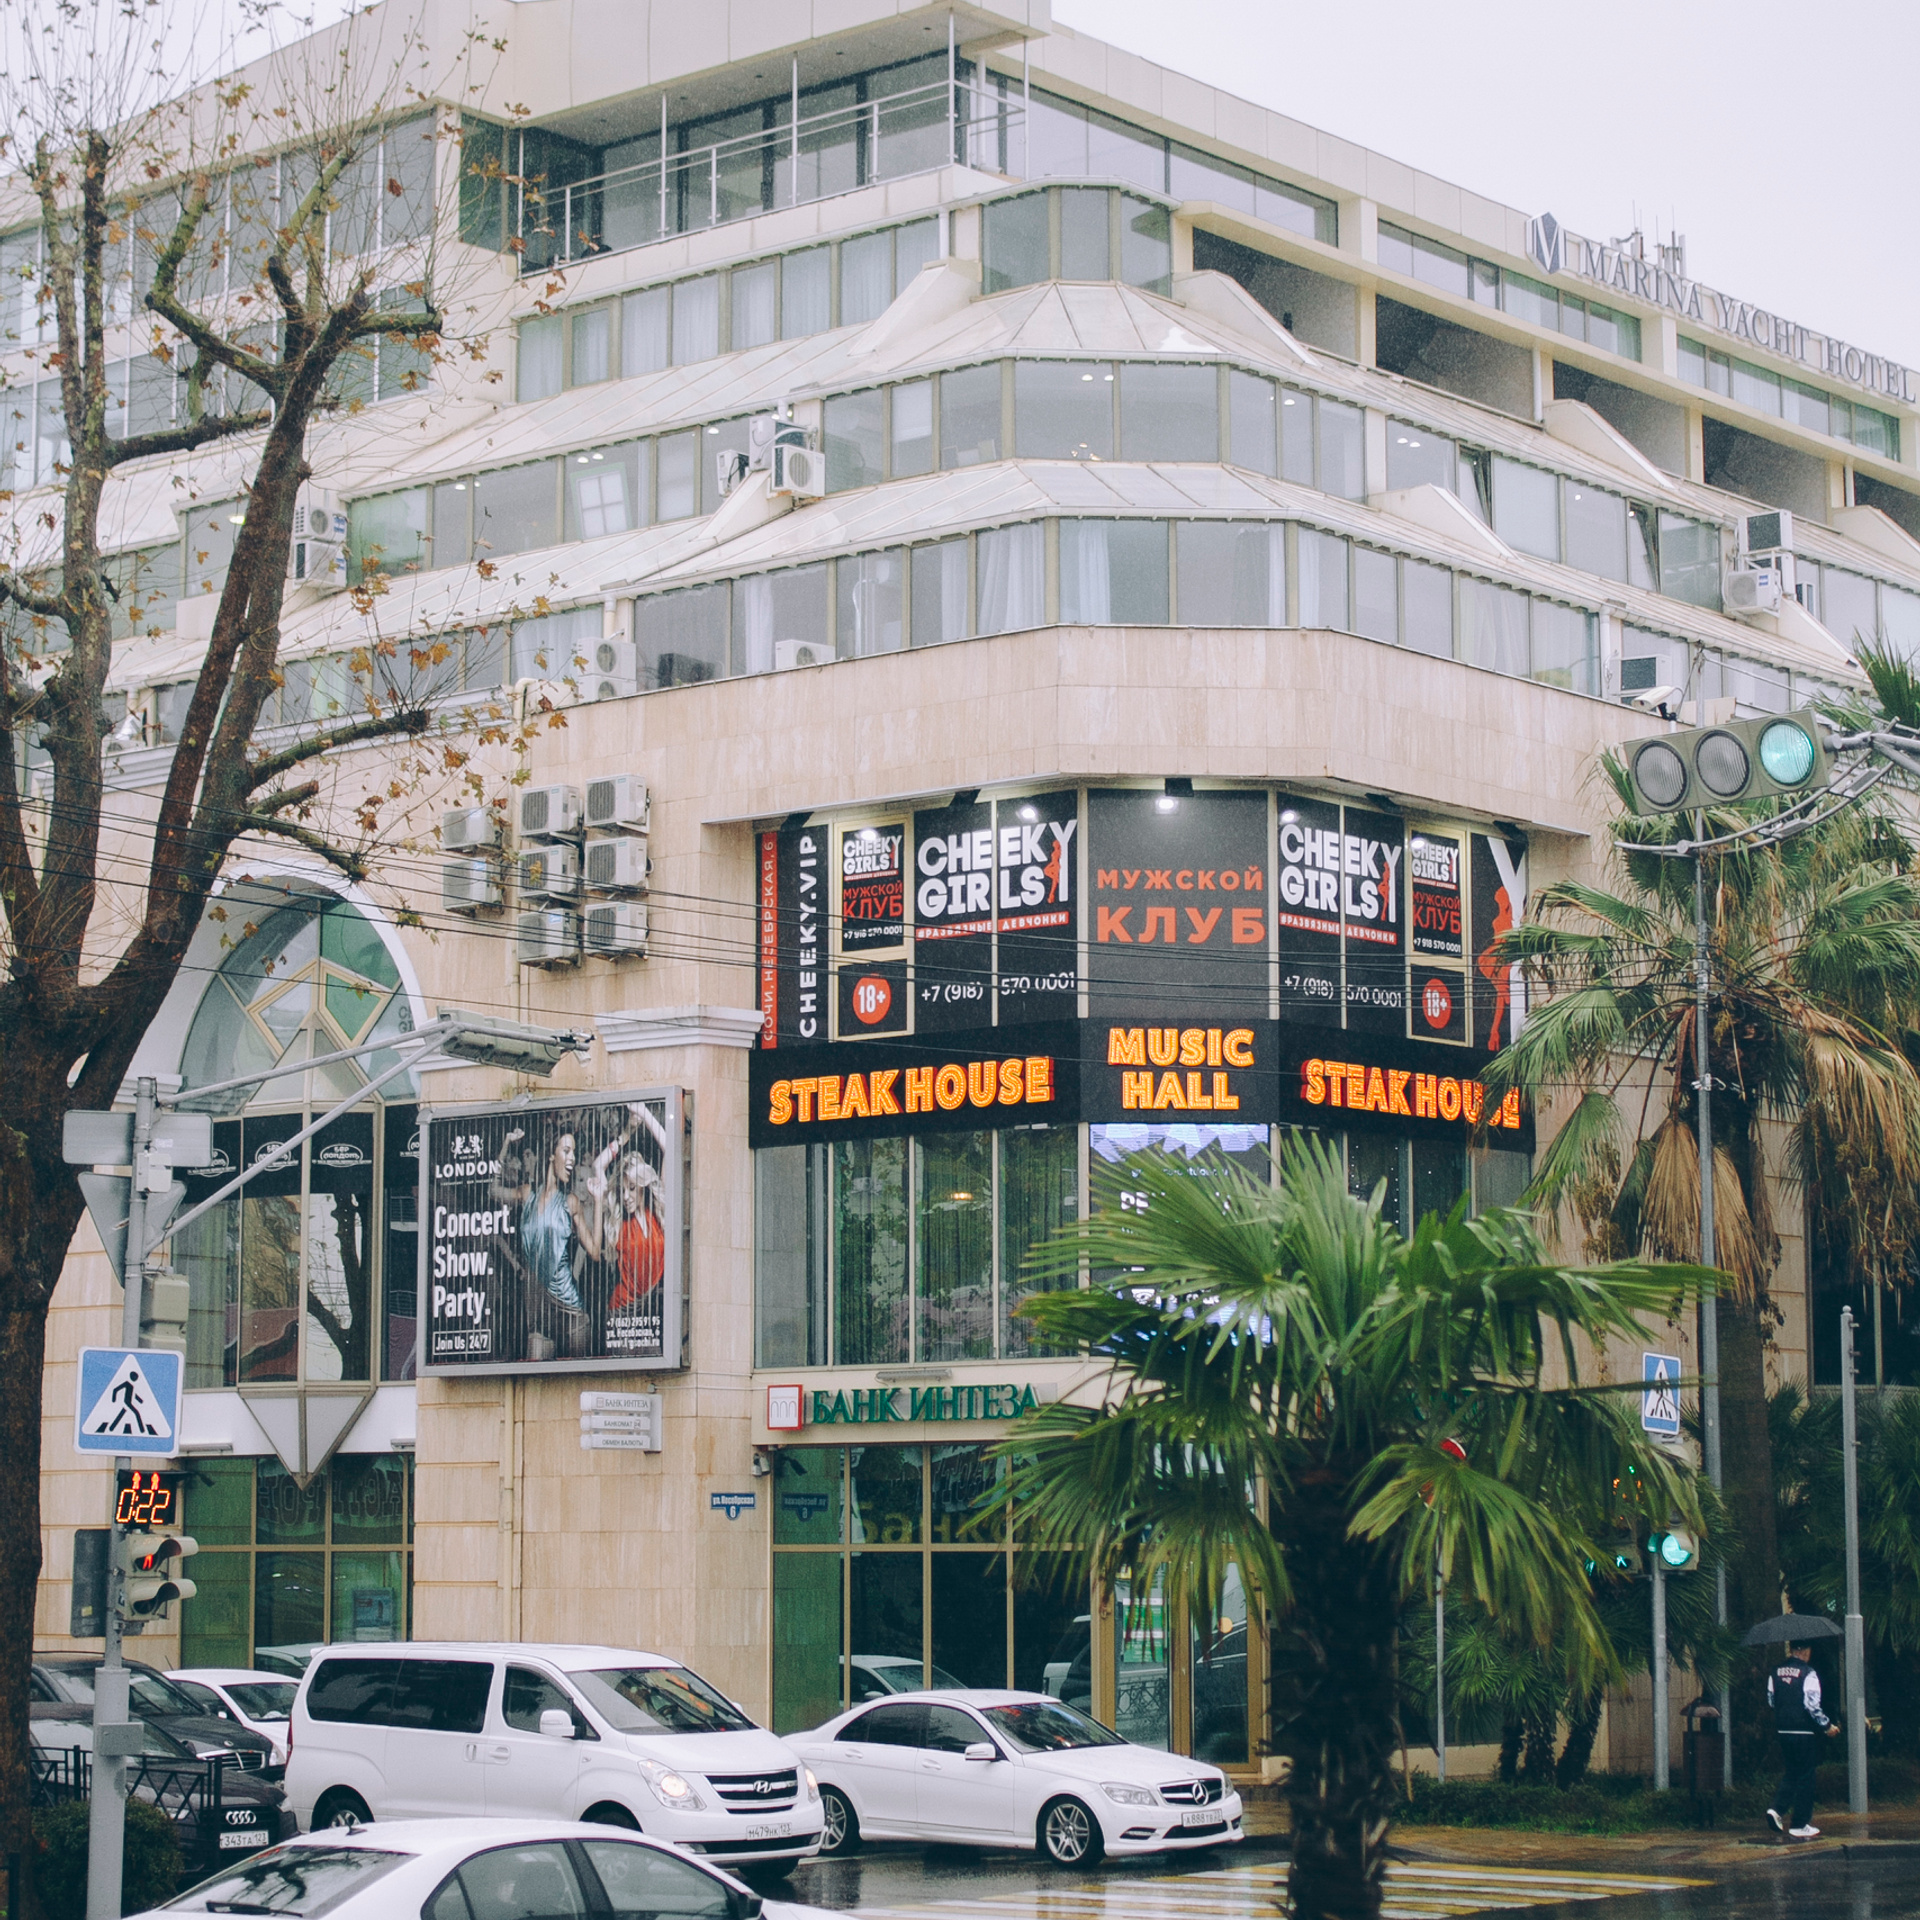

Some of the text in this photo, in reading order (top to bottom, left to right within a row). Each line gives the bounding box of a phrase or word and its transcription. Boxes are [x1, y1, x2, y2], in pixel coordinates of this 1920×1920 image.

[1580, 237, 1917, 404] MARINA YACHT HOTEL
[843, 835, 902, 868] CHEEKY
[843, 853, 891, 875] GIRLS
[917, 819, 1079, 902] CHEEKY
[1096, 864, 1264, 891] МУЖСКОЙ
[1280, 823, 1402, 923] CHEEKY
[1411, 858, 1450, 882] GIRLS
[843, 880, 903, 900] МУЖСКОЙ
[917, 865, 1046, 919] GIRLS
[1280, 865, 1380, 920] GIRLS
[1412, 890, 1461, 911] МУЖСКОЙ
[843, 894, 904, 922] КЛУБ
[1002, 912, 1067, 931] ДЕВЧОНКИ
[1412, 904, 1462, 935] КЛУБ
[799, 835, 818, 1038] CHEEKY.VIP
[1096, 906, 1266, 945] КЛУБ
[1346, 927, 1395, 943] ДЕВЧОНКИ
[857, 983, 887, 1016] 18+
[921, 985, 941, 1003] +7
[944, 981, 984, 1004] (918)
[1001, 976, 1031, 995] 570
[1284, 975, 1300, 991] +7
[1425, 988, 1448, 1018] 18+
[1107, 1027, 1255, 1067] MUSIC
[768, 1056, 1055, 1126] STEAK HOUSE
[1121, 1071, 1240, 1111] HALL
[1303, 1057, 1521, 1130] STEAK HOUE
[435, 1160, 502, 1179] LONDON
[434, 1203, 516, 1239] Concert.
[433, 1244, 494, 1278] Show.
[433, 1285, 491, 1326] Party.
[435, 1336, 453, 1351] Join
[454, 1336, 465, 1350] Us
[605, 1399, 649, 1408] БАНК ИНТЕЗА
[811, 1383, 1041, 1424] БАНК ИНТЕЗА
[730, 1505, 736, 1519] 6
